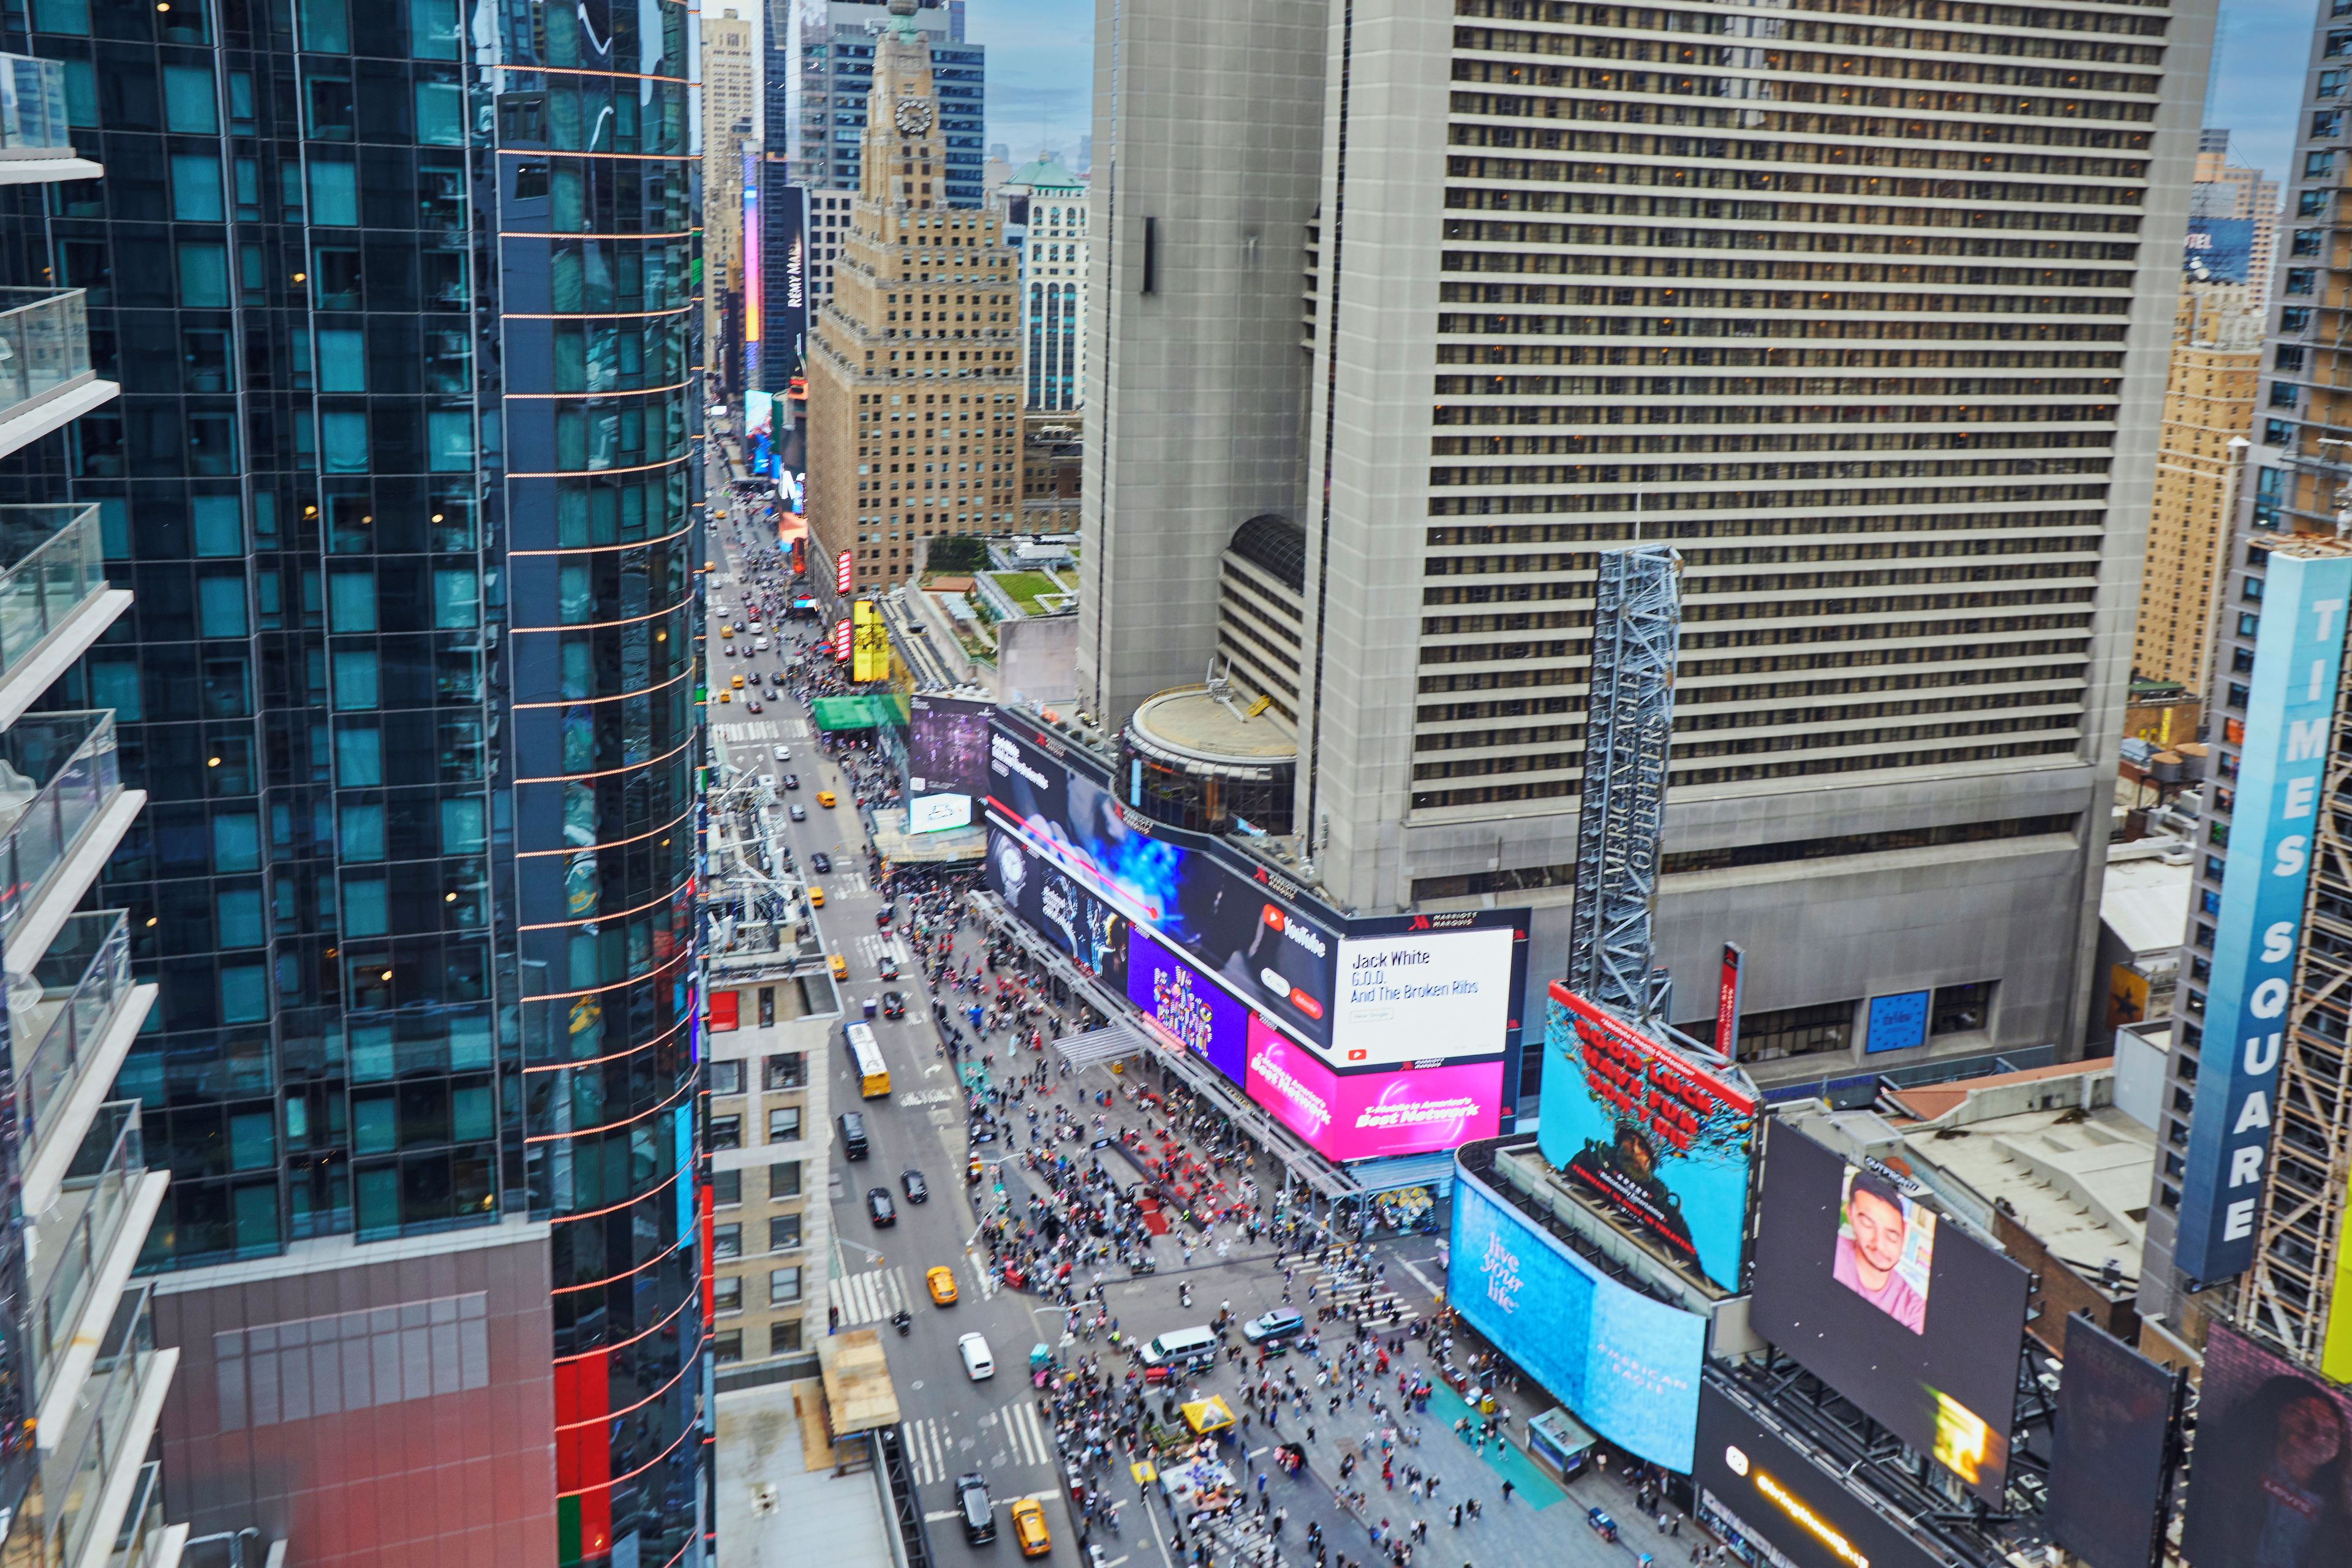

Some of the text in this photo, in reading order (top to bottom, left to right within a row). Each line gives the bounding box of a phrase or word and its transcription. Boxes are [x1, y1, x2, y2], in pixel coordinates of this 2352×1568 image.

[1433, 912, 1478, 921] MARRIOTT
[1433, 919, 1473, 928] MARQUIS
[2224, 599, 2343, 1242] TIMES SQUARE
[1284, 916, 1326, 958] YouTube
[1353, 950, 1430, 969] Jack White
[1351, 979, 1478, 1003] And The Broken Ribs
[1574, 1019, 1714, 1116] GOOD LUCK
[1583, 1043, 1698, 1134] HAVE FUN
[1355, 1104, 1480, 1128] Best Network
[1365, 1103, 1410, 1115] T-Mobile
[1422, 1098, 1472, 1110] America's
[1652, 1117, 1690, 1150] DIE
[1488, 1232, 1519, 1273] live
[1480, 1253, 1524, 1292] your
[1487, 1276, 1514, 1314] life
[1597, 1343, 1687, 1390] AMERICAN
[1613, 1363, 1664, 1395] EAGLE
